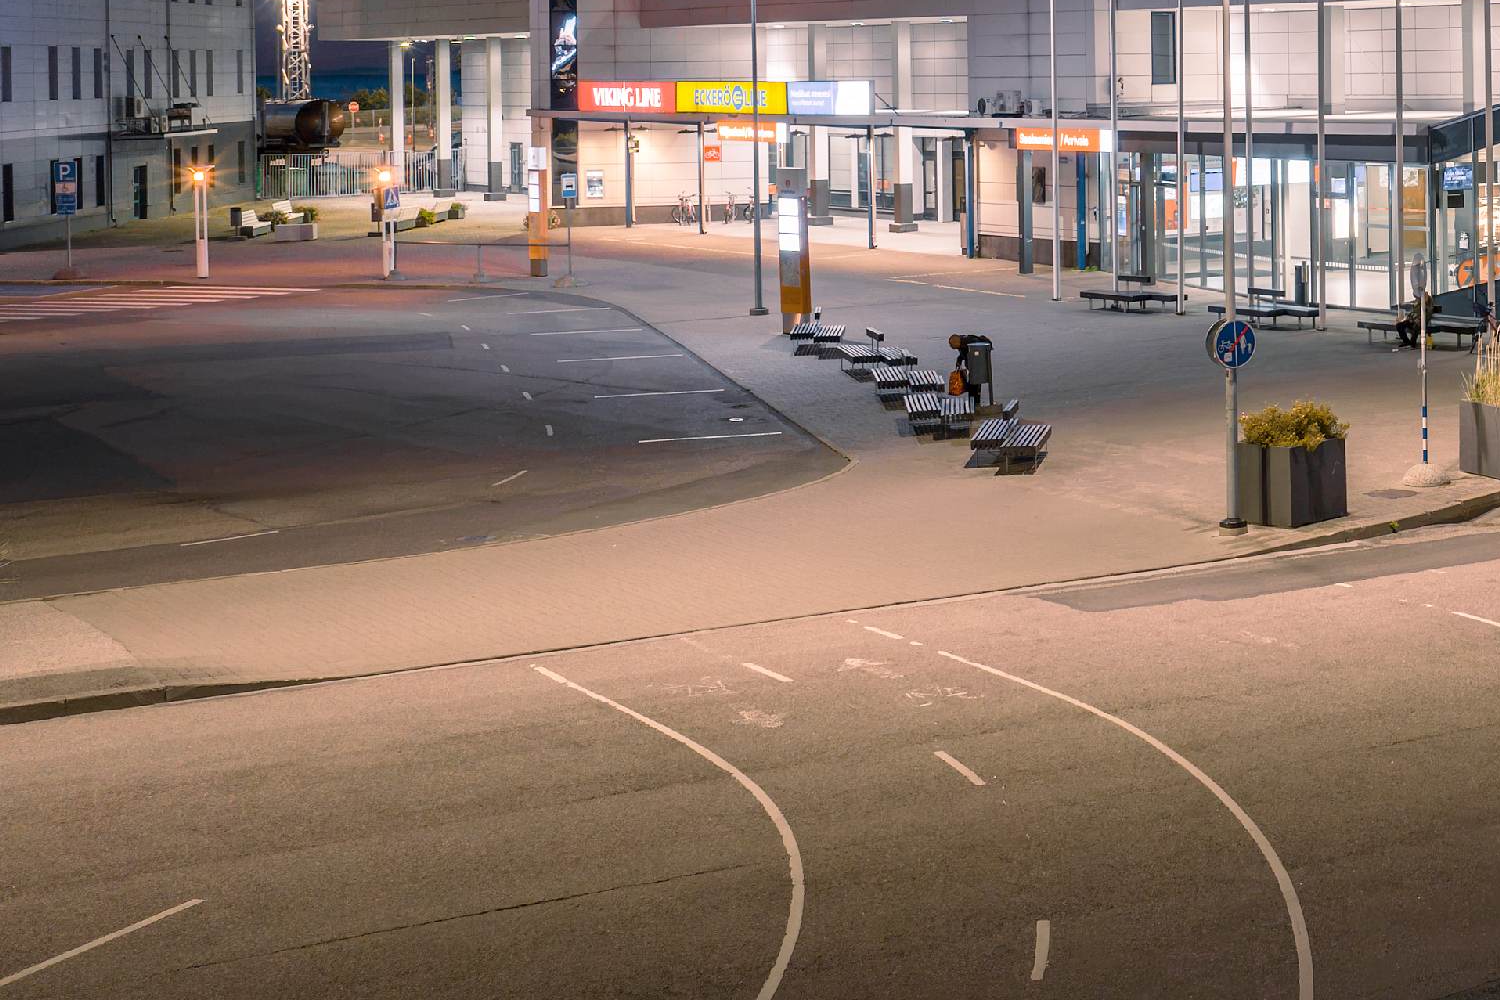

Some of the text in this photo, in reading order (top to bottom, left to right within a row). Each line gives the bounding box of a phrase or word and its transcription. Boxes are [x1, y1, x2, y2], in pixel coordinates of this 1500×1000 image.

[592, 87, 662, 108] VIKING LINE
[694, 85, 732, 106] ECKERÖ
[60, 164, 71, 180] P
